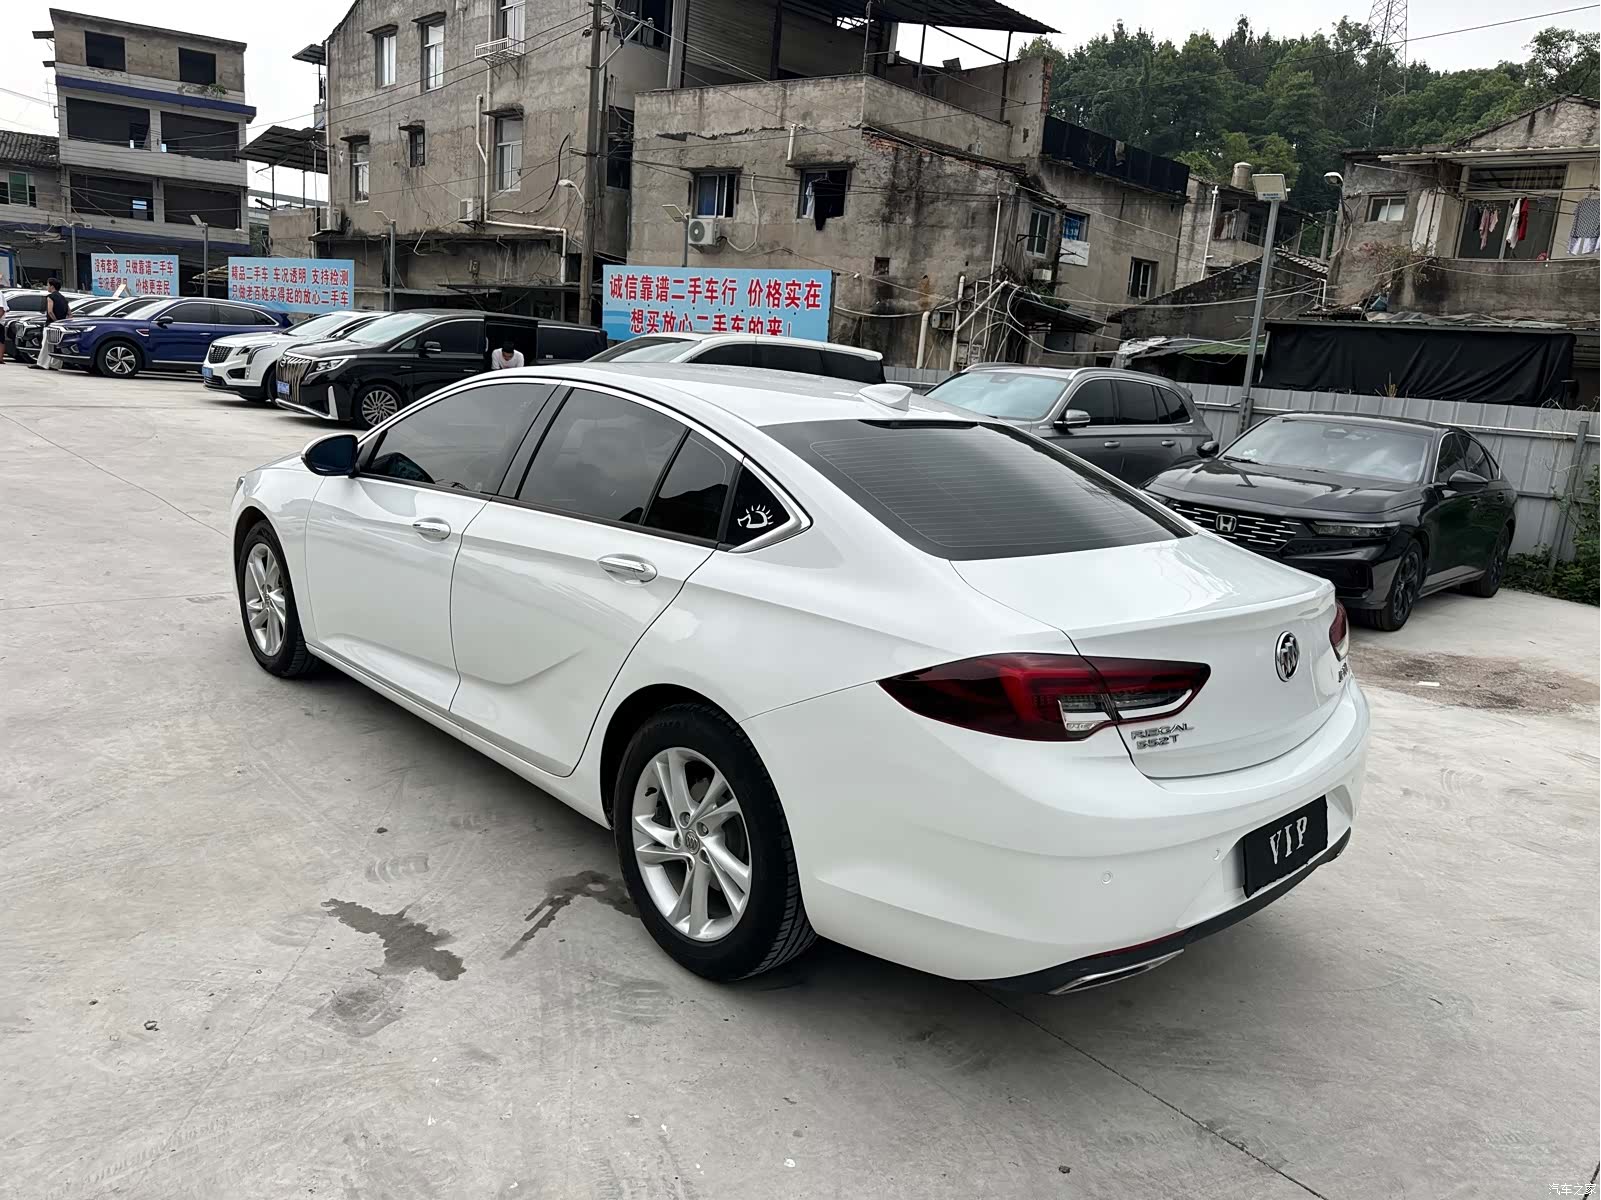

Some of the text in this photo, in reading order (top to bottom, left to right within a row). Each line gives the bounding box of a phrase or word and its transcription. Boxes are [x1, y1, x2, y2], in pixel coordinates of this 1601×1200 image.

[231, 265, 349, 287] 精品二手车 车况透明 支持检测
[231, 284, 349, 307] 只做老百姓买得起的放心二手车
[609, 274, 822, 309] 诚信靠谱二手车行 价格实在
[1131, 722, 1194, 740] REGAL
[1269, 816, 1308, 865] VIP
